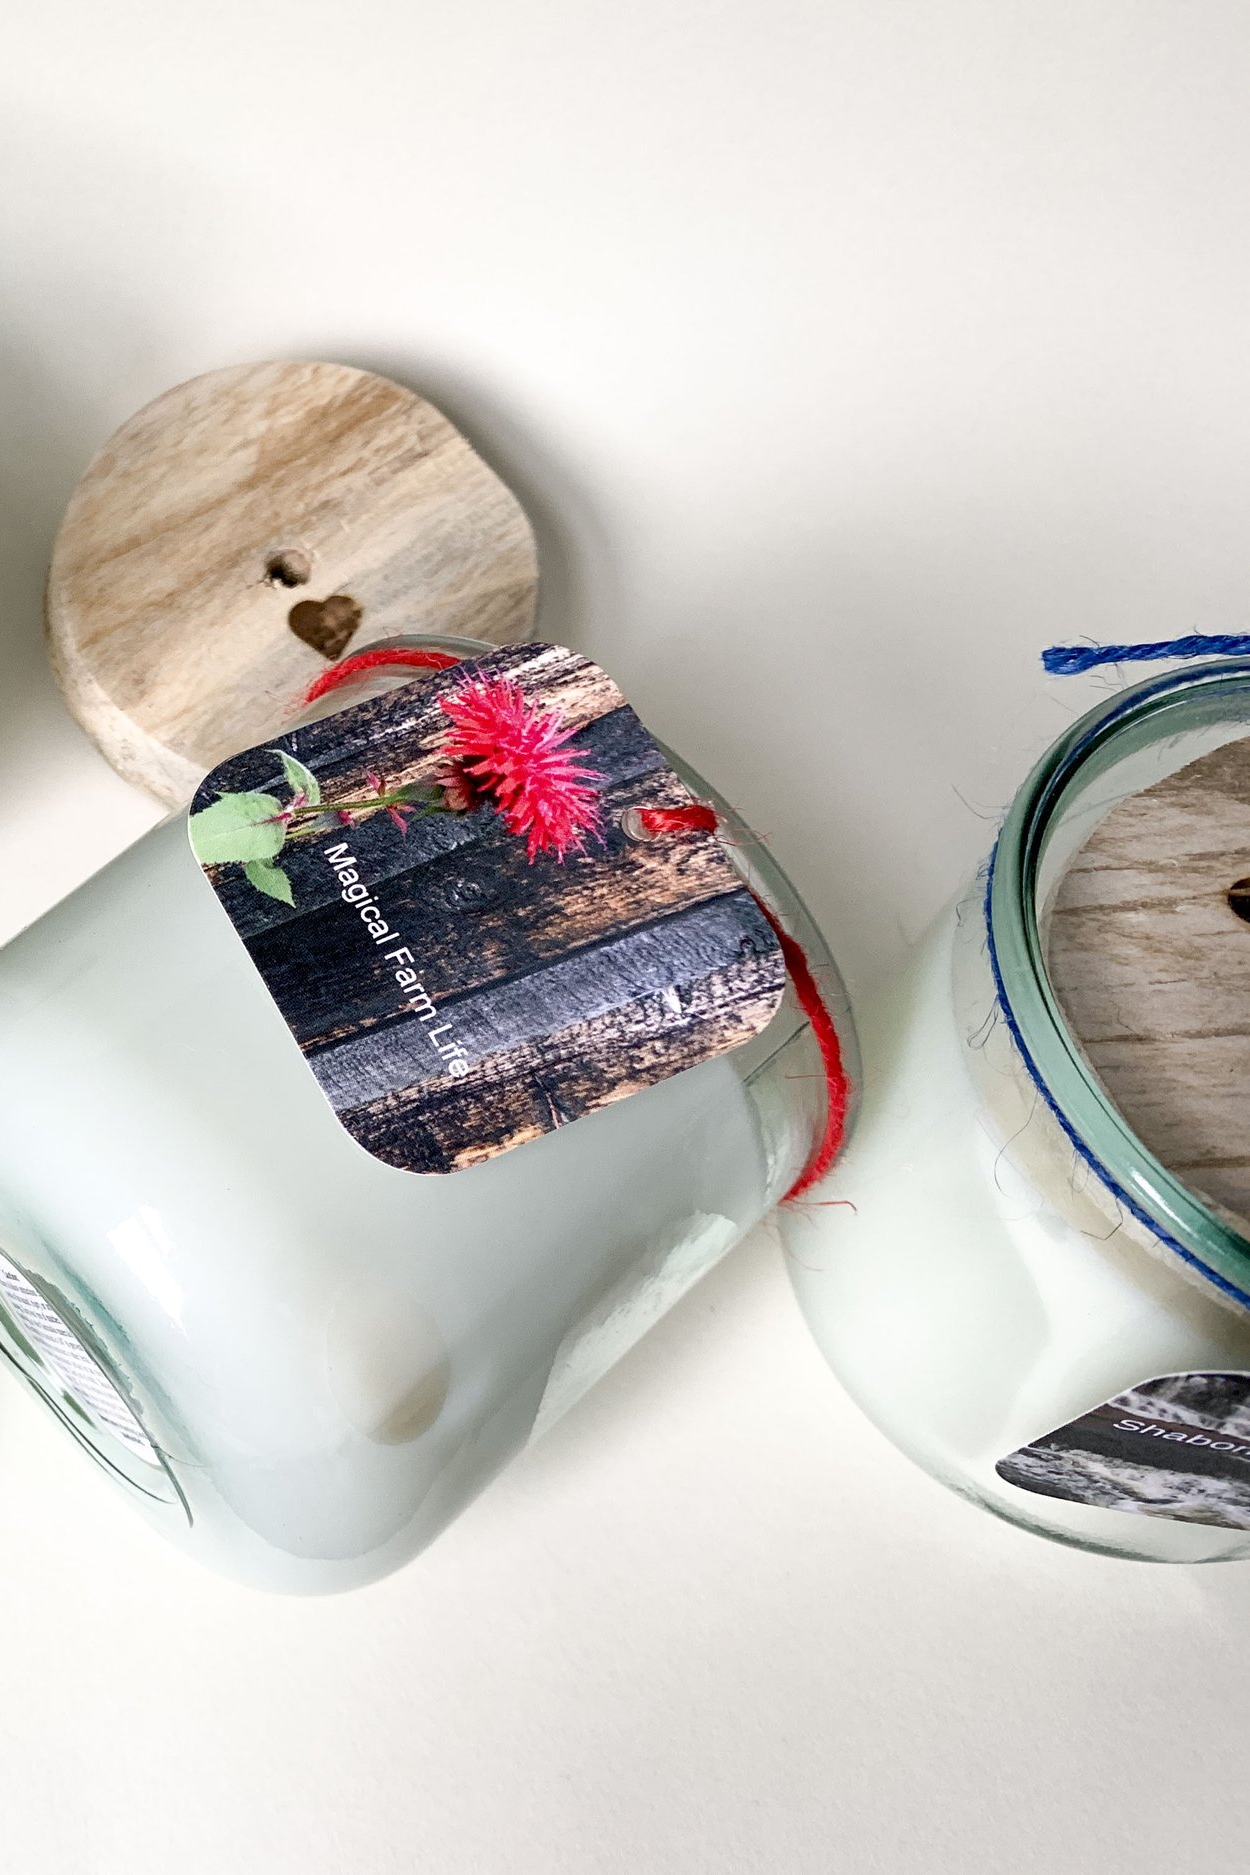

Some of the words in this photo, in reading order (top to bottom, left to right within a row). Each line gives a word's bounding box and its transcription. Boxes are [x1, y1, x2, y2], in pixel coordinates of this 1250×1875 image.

[323, 842, 400, 945] Magical
[384, 946, 437, 1022] Farm
[427, 1022, 469, 1078] Life
